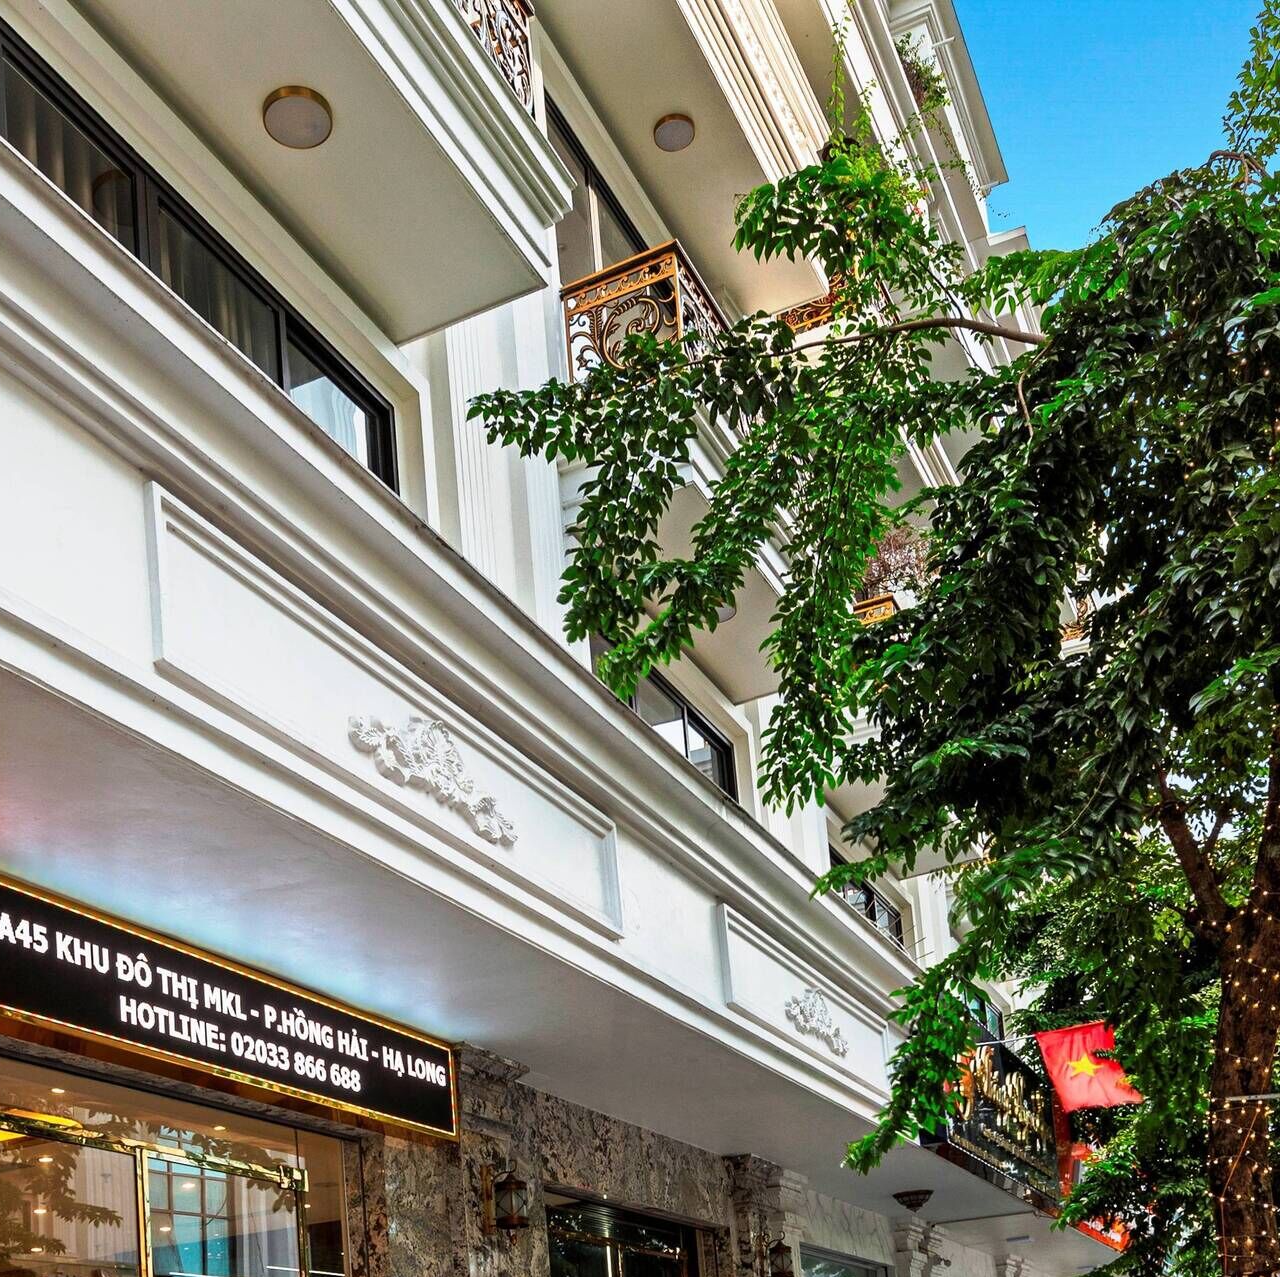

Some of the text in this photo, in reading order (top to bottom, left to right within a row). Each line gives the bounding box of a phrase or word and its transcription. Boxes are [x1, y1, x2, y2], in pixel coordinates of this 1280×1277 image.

[56, 931, 110, 974] KHU
[116, 952, 153, 988] ĐÔ
[157, 966, 199, 1010] THỊ
[203, 983, 248, 1021] MKL
[264, 1004, 334, 1050] P.HỒNG
[337, 1028, 369, 1062] HẢI
[382, 1046, 406, 1078] HẠ
[407, 1055, 447, 1087] LONG
[120, 995, 362, 1093] HOTLINE: 02033 866 688
